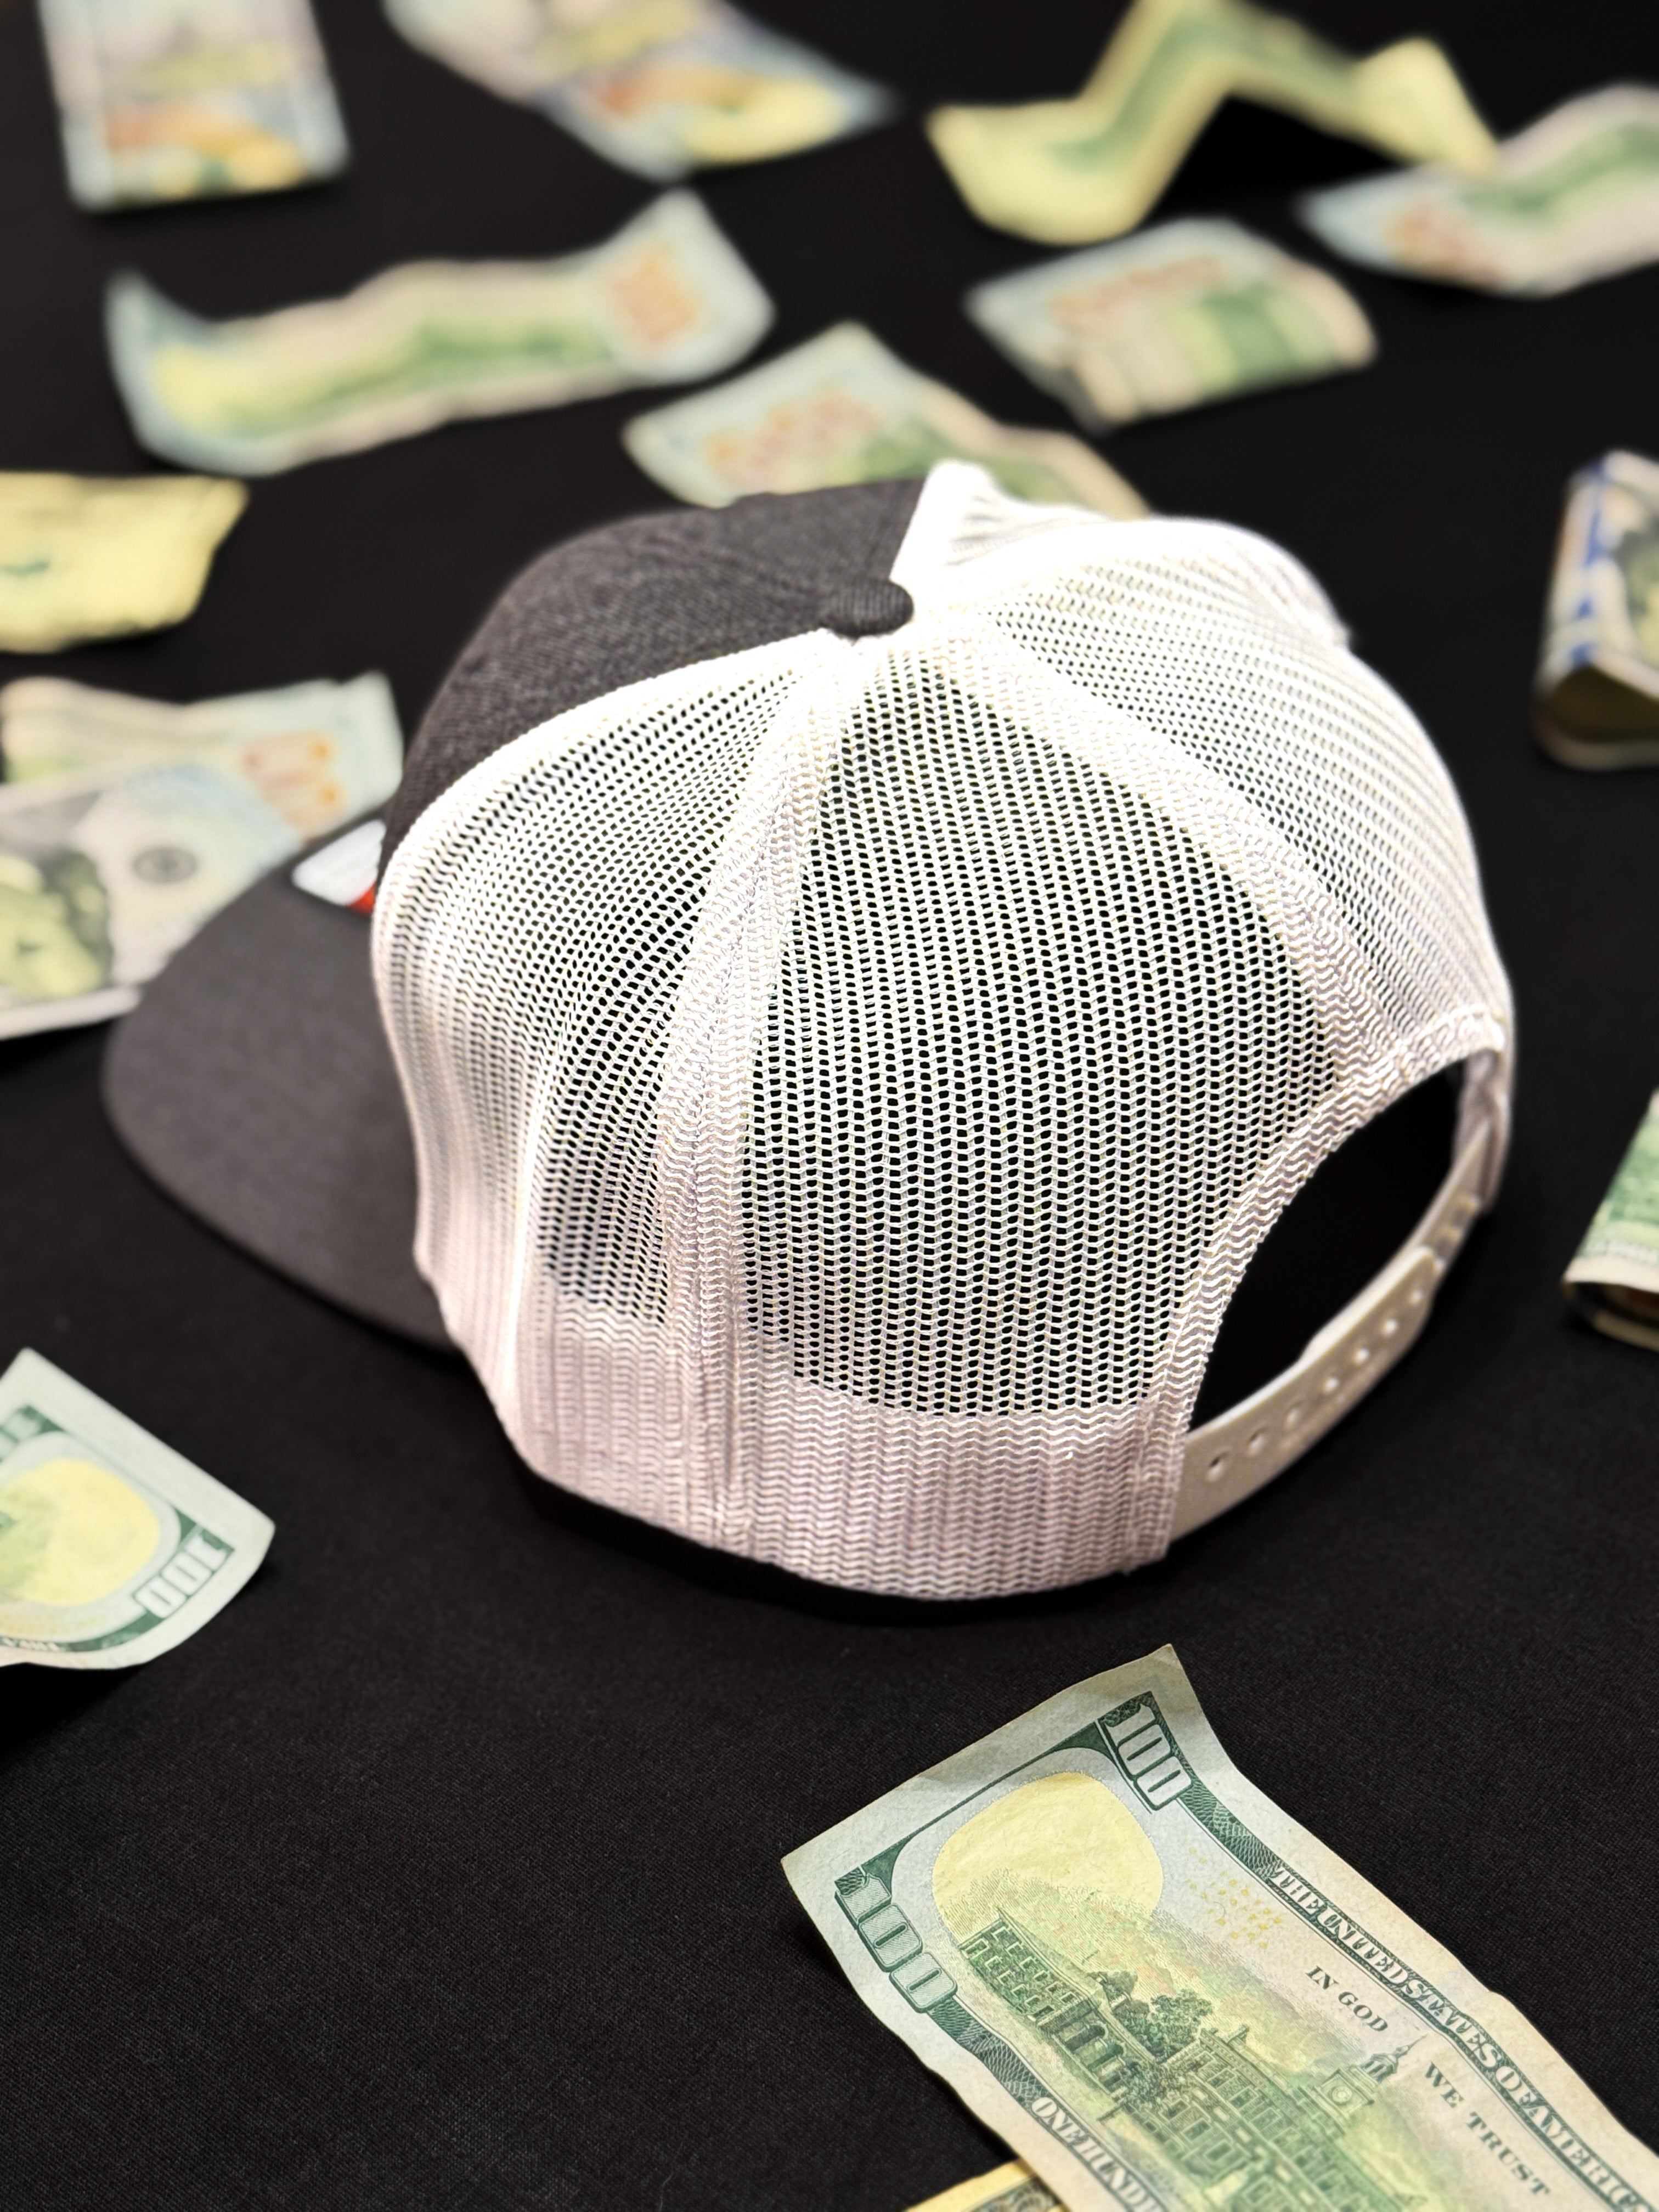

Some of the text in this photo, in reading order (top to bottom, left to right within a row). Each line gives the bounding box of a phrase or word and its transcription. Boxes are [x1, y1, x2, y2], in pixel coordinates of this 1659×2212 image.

[132, 1534, 228, 1618] 100
[1103, 1702, 1193, 1810] 100
[834, 1872, 957, 2013] 100
[1268, 1866, 1649, 2212] THE UNITED STATES OF AMERIC
[1305, 1965, 1551, 2195] IN GOD WE TRUST
[1031, 2096, 1087, 2143] ONE
